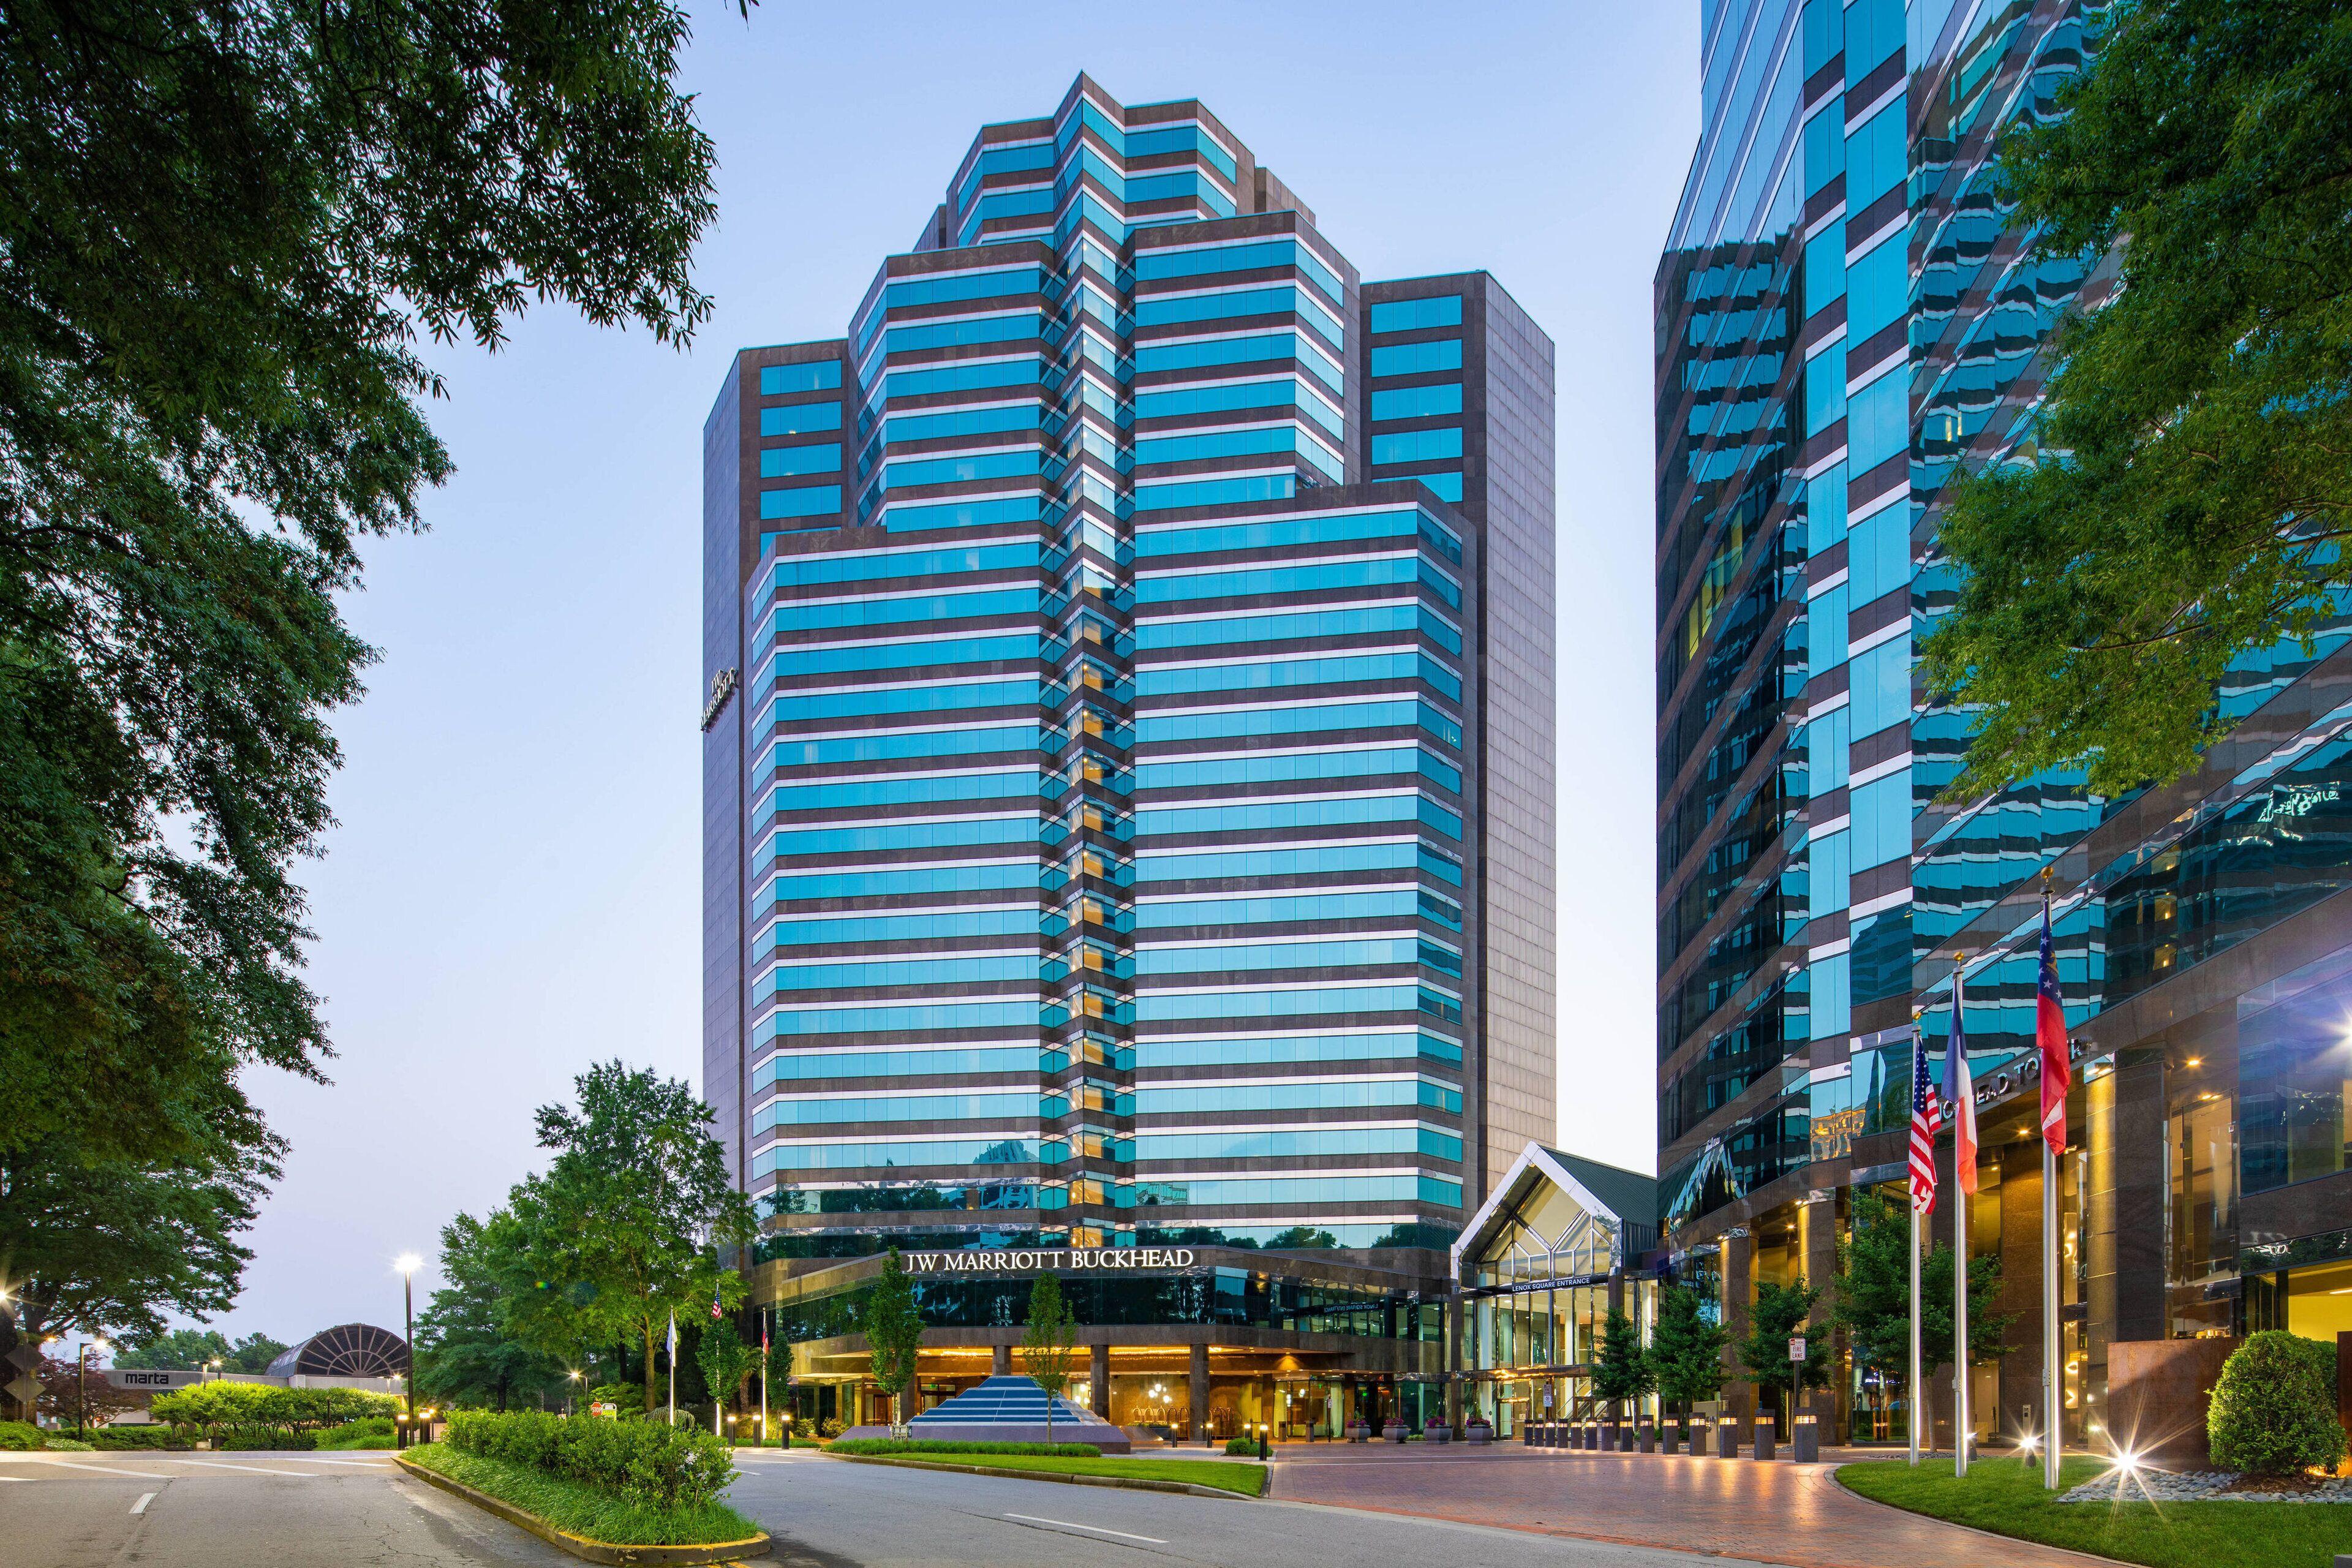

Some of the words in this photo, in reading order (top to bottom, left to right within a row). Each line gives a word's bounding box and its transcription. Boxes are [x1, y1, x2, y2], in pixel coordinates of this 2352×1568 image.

[700, 667, 736, 726] MARRIOTT
[907, 1254, 939, 1272] JW
[943, 1251, 1065, 1271] MARRIOTT
[1071, 1249, 1194, 1268] BUCKHEAD
[1557, 1278, 1590, 1287] ENTRANCE
[125, 1373, 169, 1384] marta
